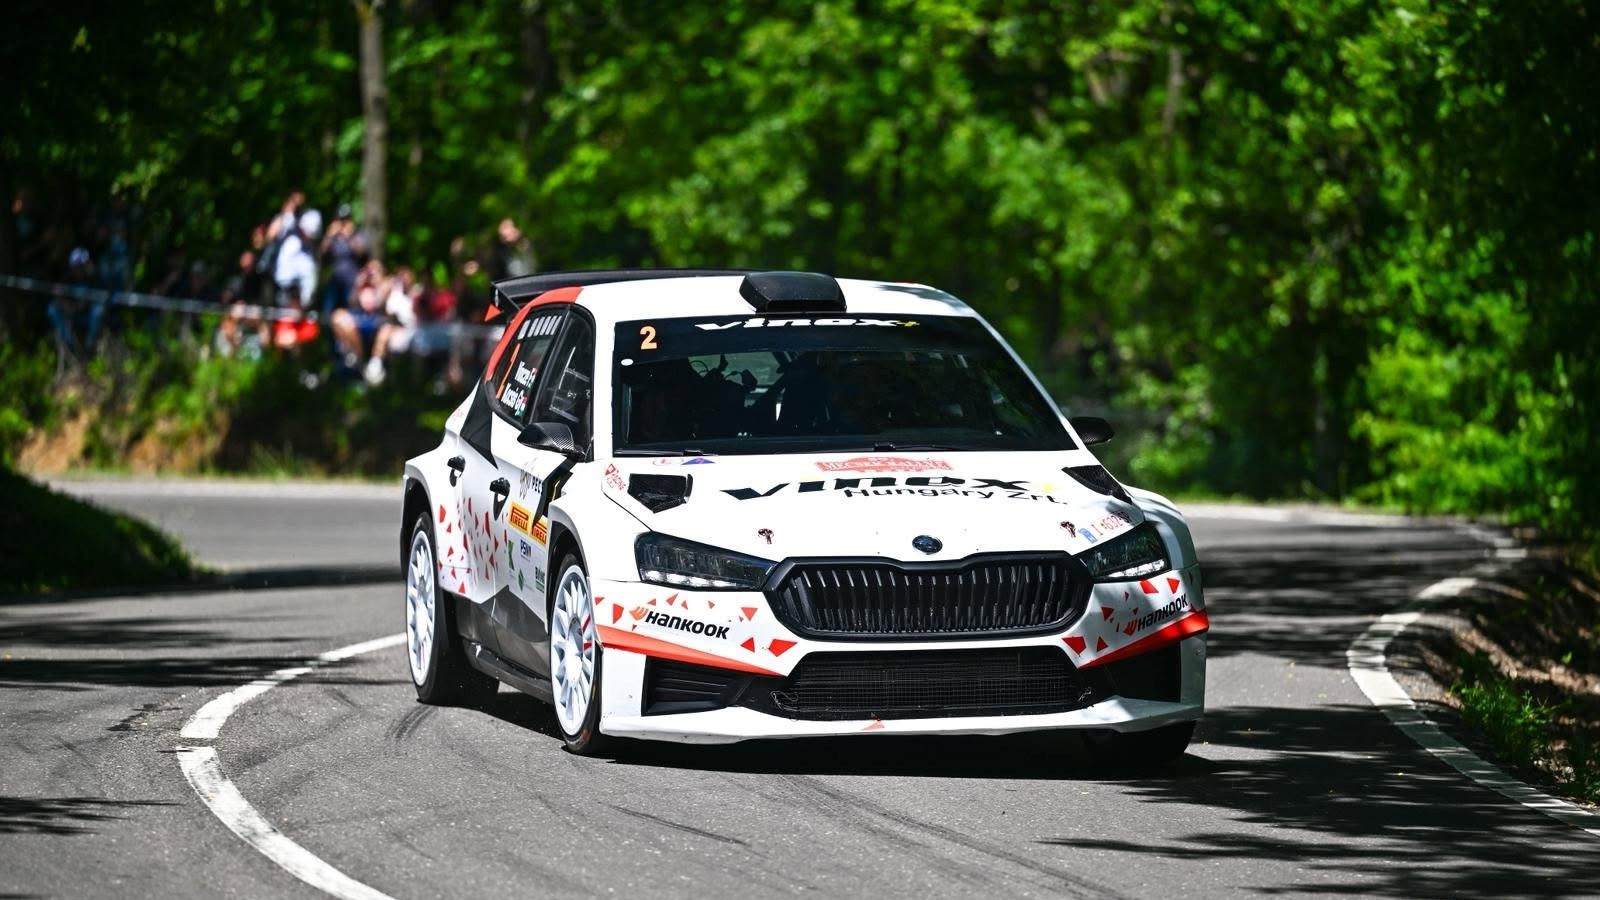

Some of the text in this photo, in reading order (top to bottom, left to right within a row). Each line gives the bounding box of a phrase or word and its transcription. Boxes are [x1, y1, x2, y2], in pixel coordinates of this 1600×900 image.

[640, 326, 657, 350] 2
[843, 487, 995, 499] Hungary
[511, 506, 529, 532] PIRELLI
[645, 611, 729, 640] HANKOOK
[1138, 594, 1188, 631] HANKOOK
